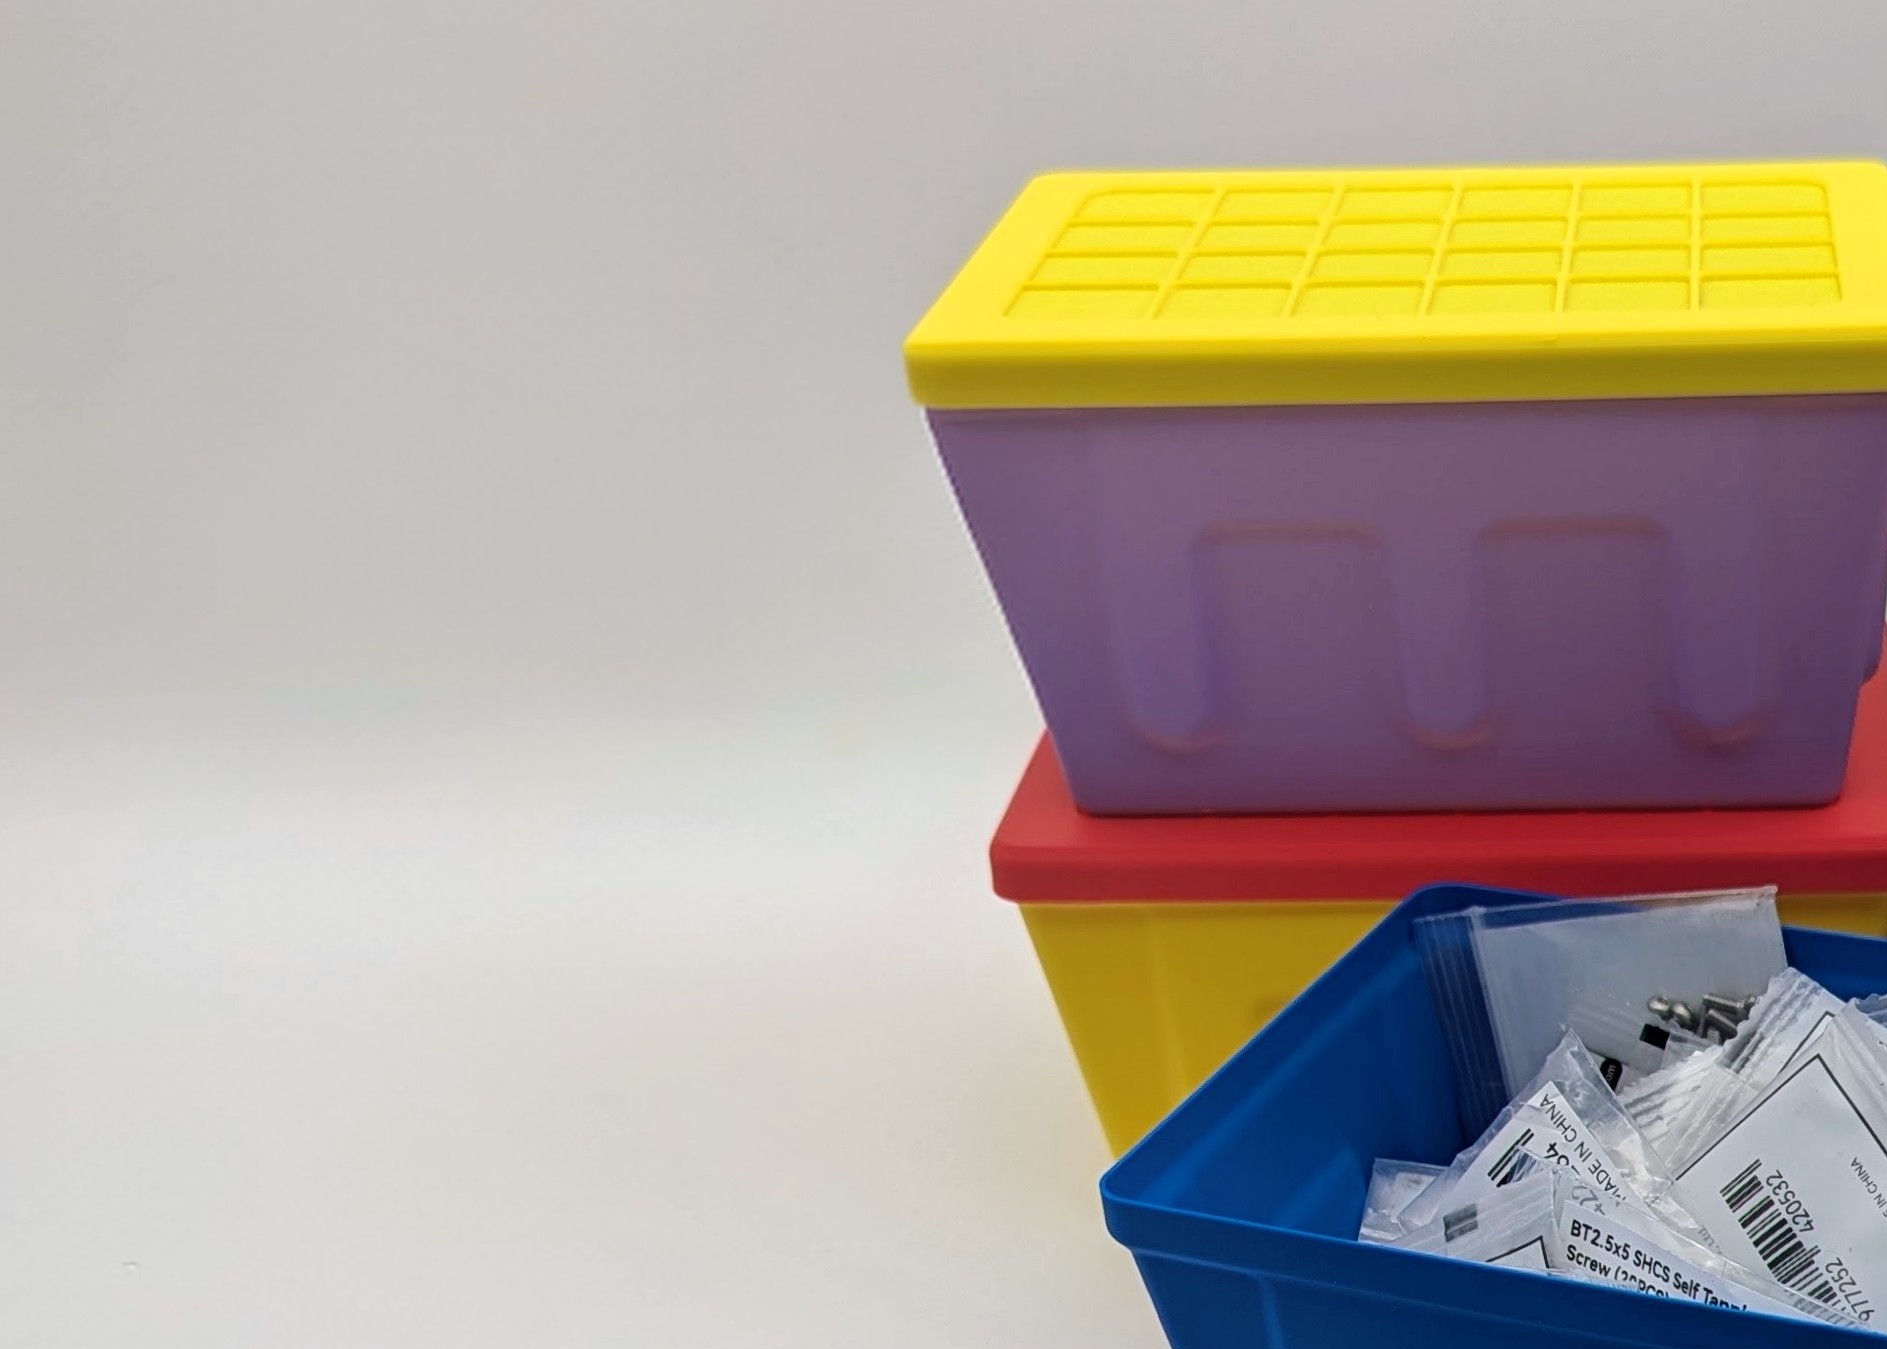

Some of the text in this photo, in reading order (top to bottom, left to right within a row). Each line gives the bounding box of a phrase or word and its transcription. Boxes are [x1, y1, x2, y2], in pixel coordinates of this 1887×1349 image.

[1540, 1094, 1577, 1143] CHINA
[1574, 1141, 1592, 1163] IN
[1850, 1157, 1878, 1194] CHINA
[1873, 1193, 1887, 1208] IN
[1566, 1244, 1612, 1277] Screw
[1570, 1219, 1631, 1261] BT2.5x5
[1633, 1250, 1671, 1283] SHCS
[1672, 1272, 1701, 1300] Self
[1766, 1169, 1876, 1322] 977252 420532
